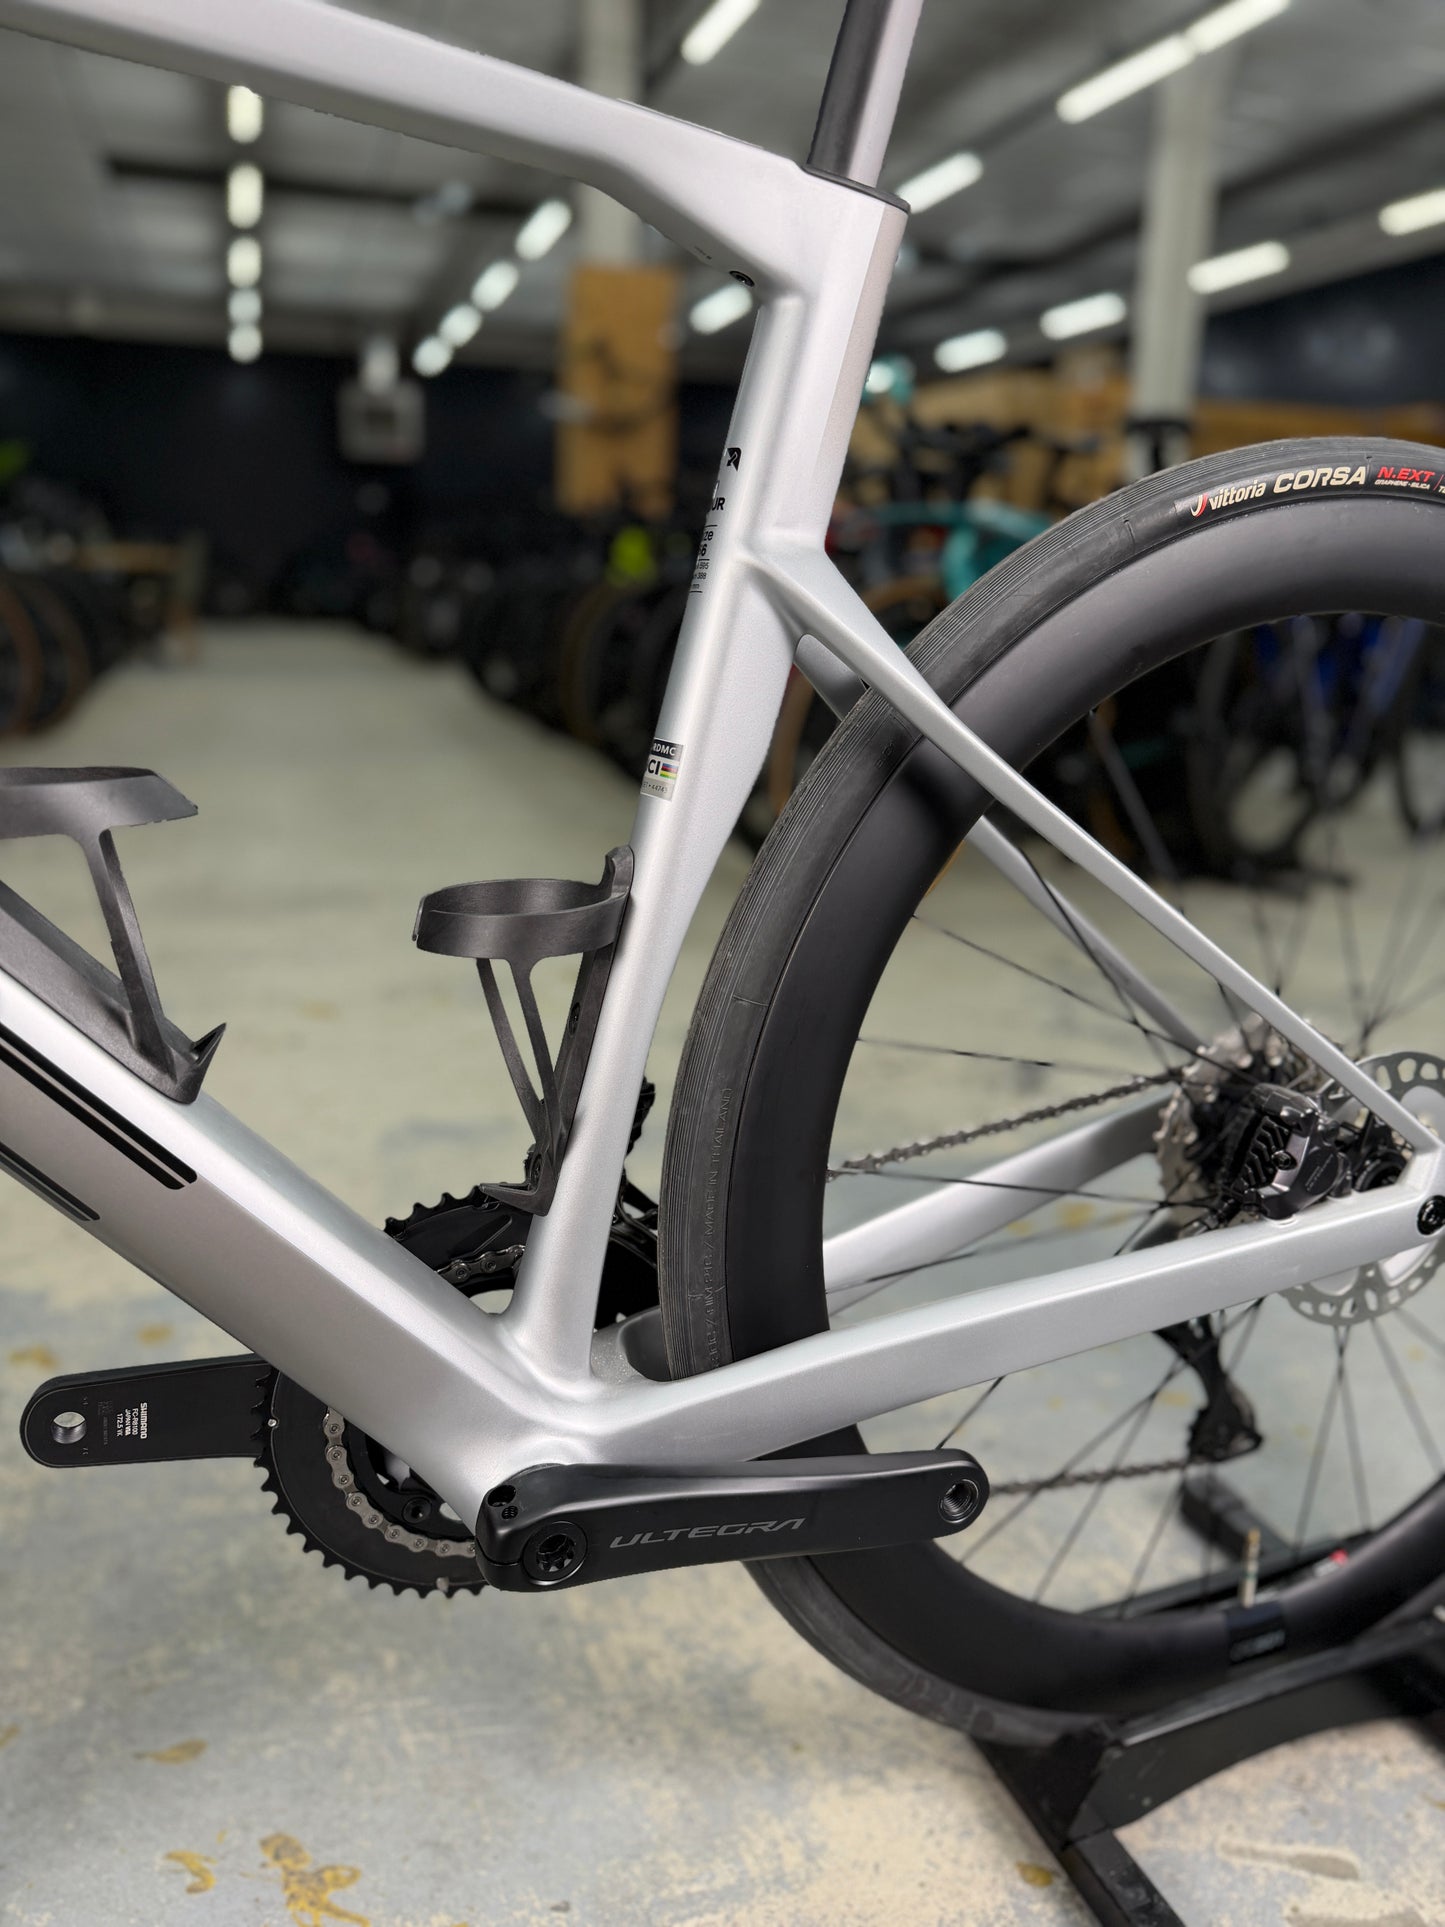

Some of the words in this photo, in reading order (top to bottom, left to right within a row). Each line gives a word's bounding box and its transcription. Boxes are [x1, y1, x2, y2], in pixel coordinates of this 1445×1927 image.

[1209, 480, 1266, 510] vittoria
[1273, 466, 1367, 494] CORSA
[1377, 466, 1436, 483] N.EXT
[711, 497, 726, 511] UR
[704, 530, 714, 541] ze
[647, 759, 661, 775] CI
[140, 1402, 148, 1439] SHIMANO
[609, 1517, 806, 1549] ULTEGRA
